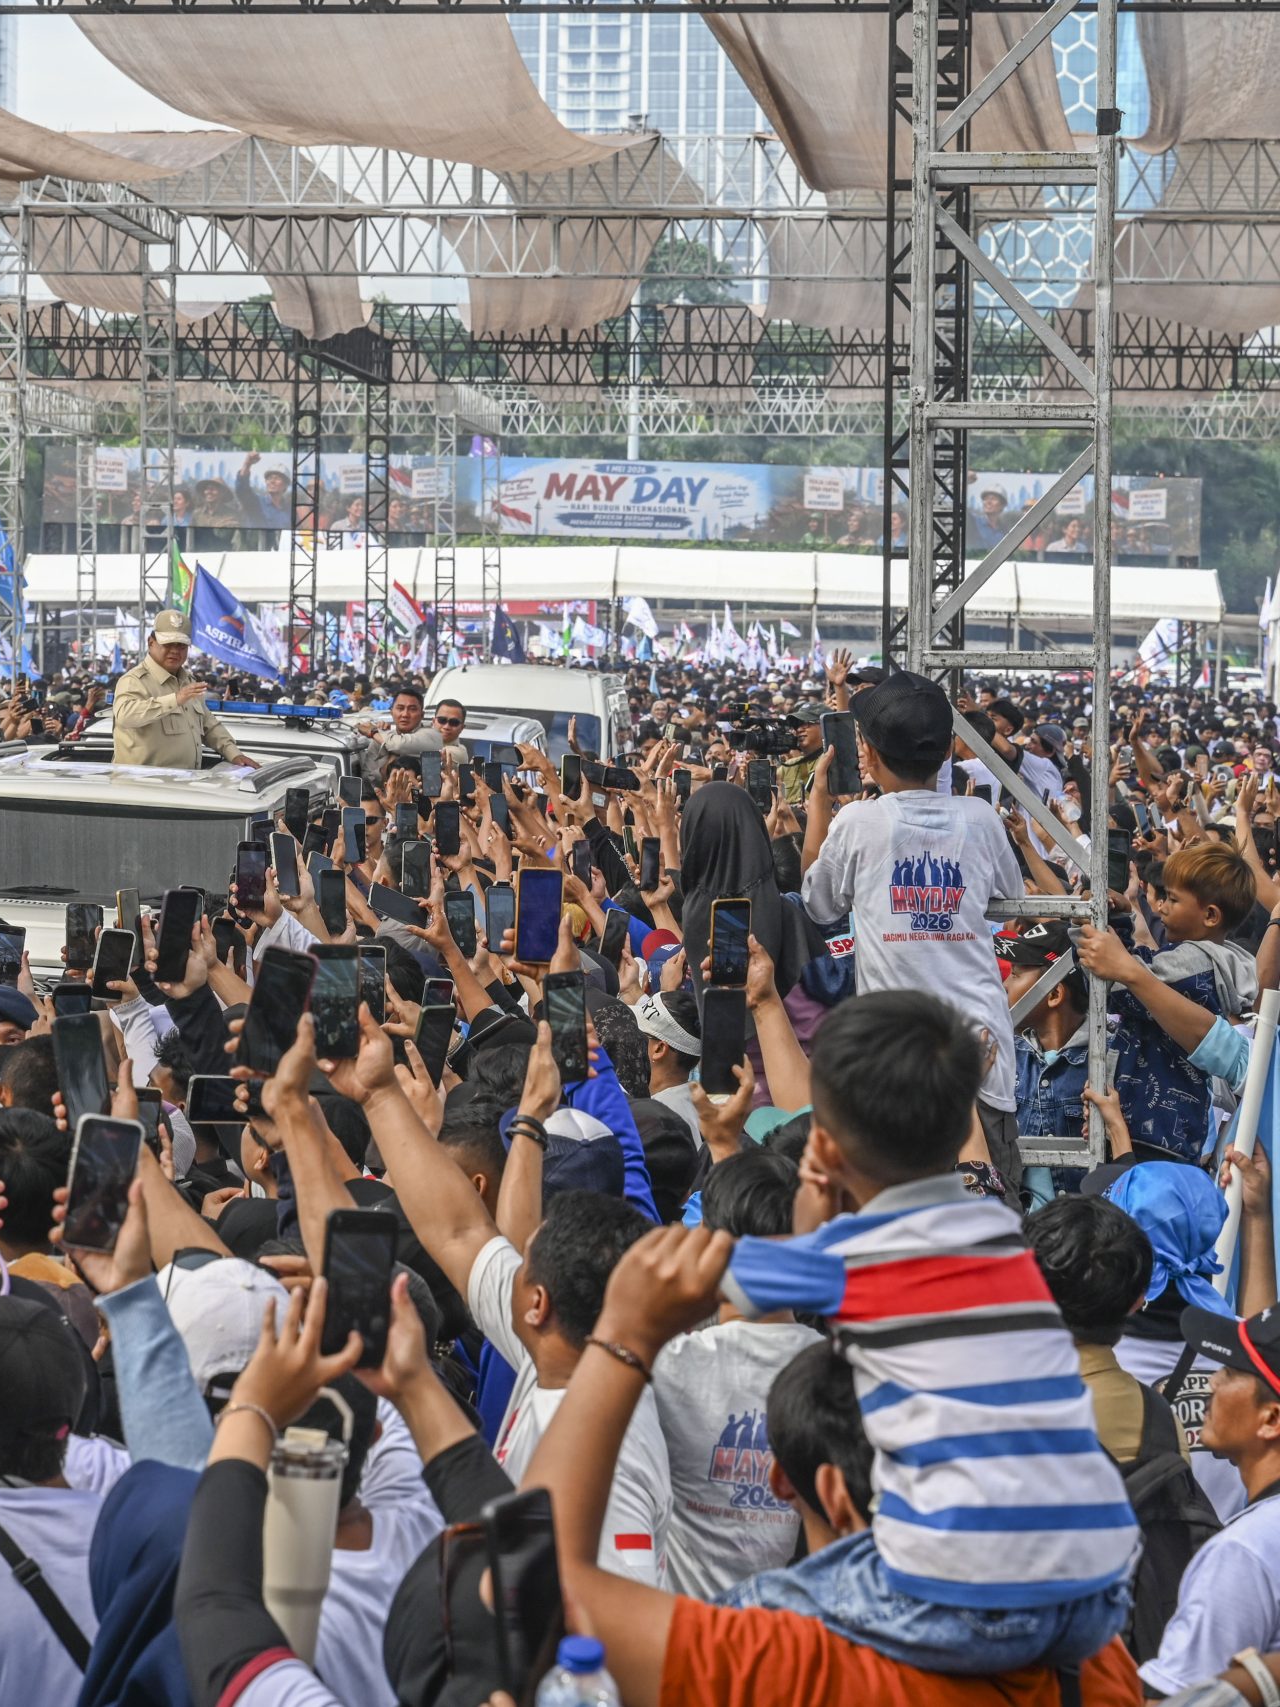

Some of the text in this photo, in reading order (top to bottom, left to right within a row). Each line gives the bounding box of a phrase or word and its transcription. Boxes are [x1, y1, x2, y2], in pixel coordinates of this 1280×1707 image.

[543, 473, 629, 502] MAY
[630, 476, 709, 506] DAY
[571, 503, 590, 511] HARI
[622, 505, 687, 514] INTERNASIONAL
[891, 886, 965, 913] MAYDAY
[912, 914, 951, 930] 2026
[882, 933, 907, 942] BAGIMU
[1201, 1340, 1232, 1356] SPORTS
[711, 1446, 775, 1485] MAY
